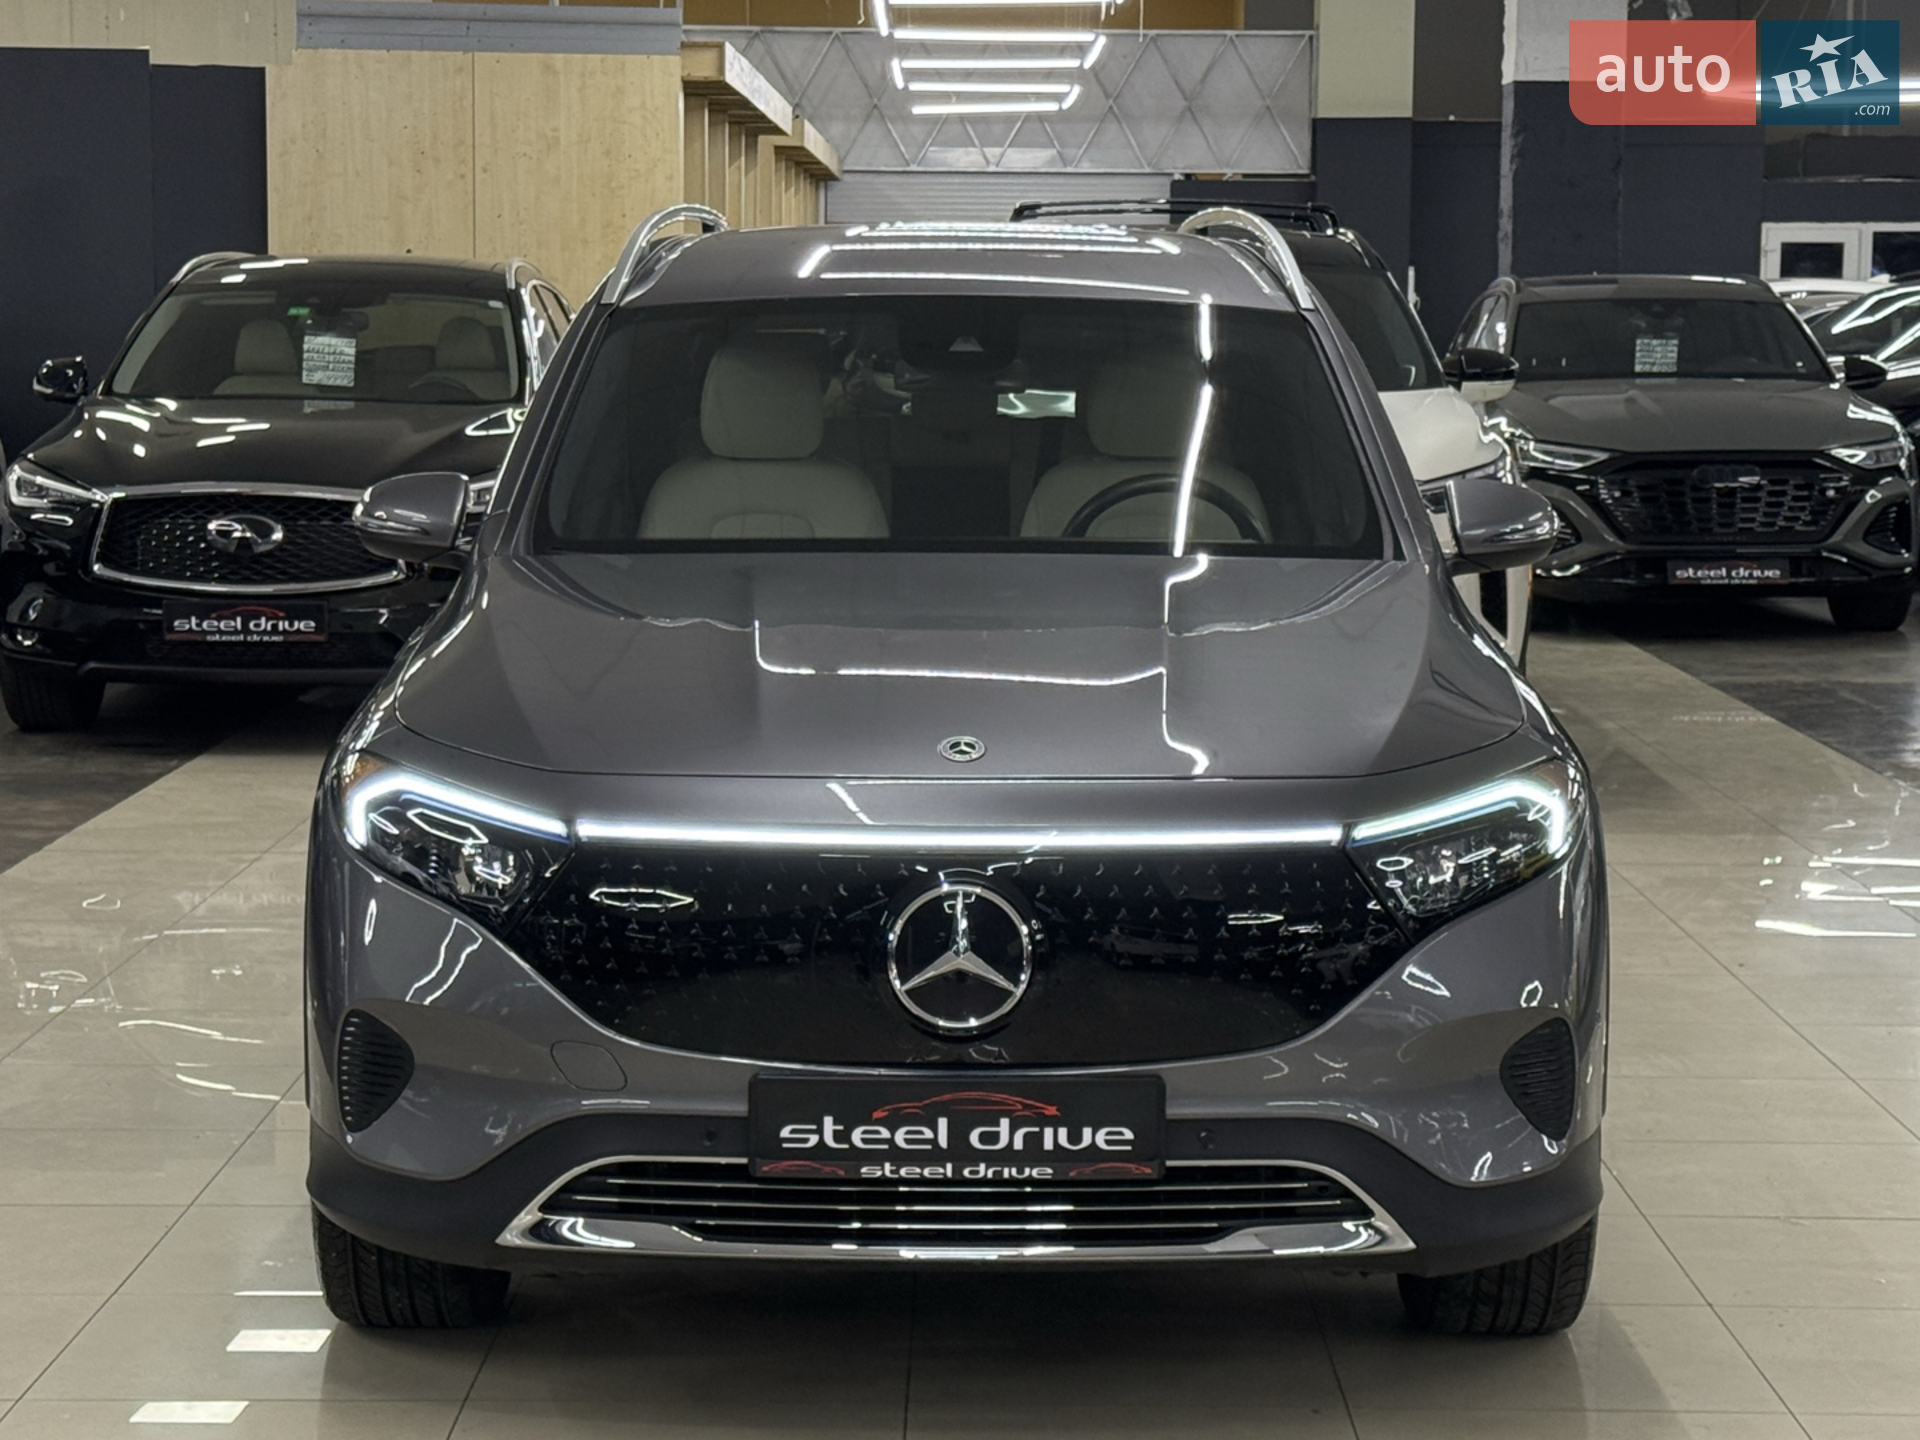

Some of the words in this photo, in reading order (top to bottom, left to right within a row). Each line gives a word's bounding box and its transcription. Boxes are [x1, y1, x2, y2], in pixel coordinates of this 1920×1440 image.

[1675, 567, 1727, 578] steel
[1731, 567, 1781, 578] drive
[173, 616, 242, 632] steel
[248, 616, 316, 632] drive
[206, 633, 244, 642] steel
[779, 1115, 949, 1151] steel
[968, 1117, 1135, 1151] drive
[860, 1162, 953, 1179] steel
[962, 1162, 1054, 1179] drive
